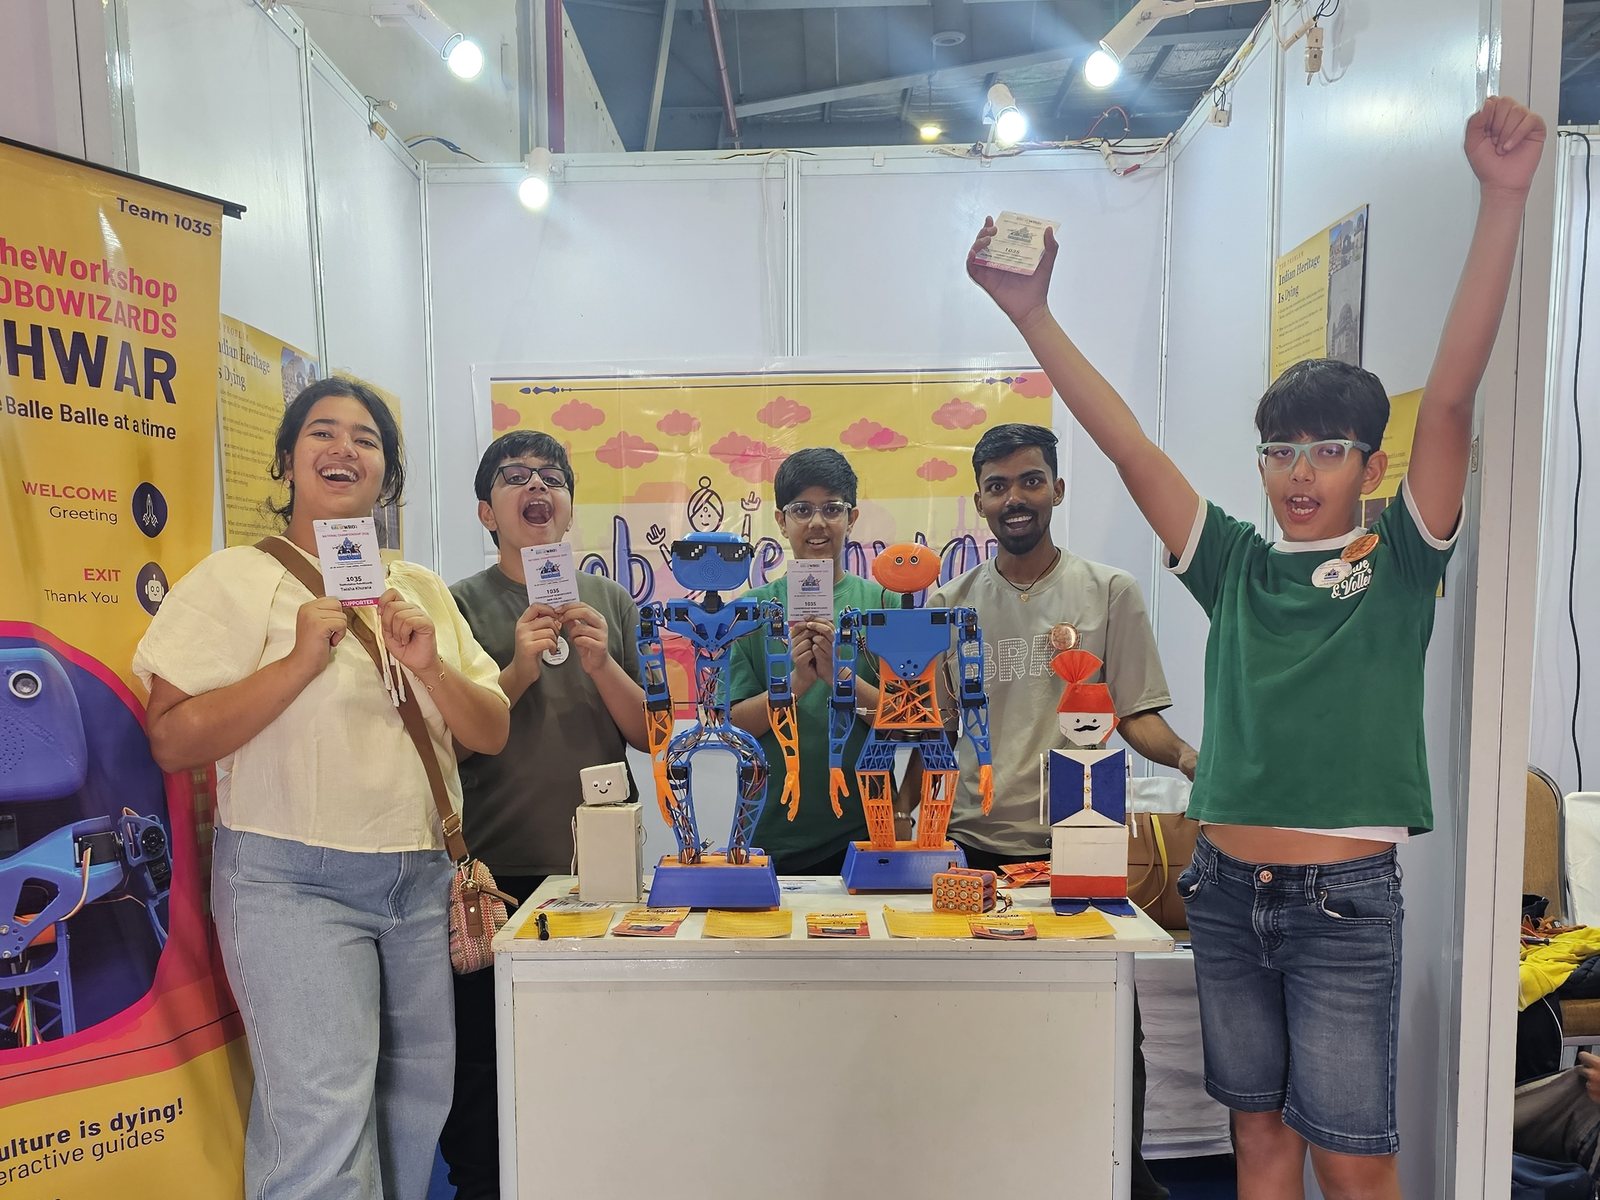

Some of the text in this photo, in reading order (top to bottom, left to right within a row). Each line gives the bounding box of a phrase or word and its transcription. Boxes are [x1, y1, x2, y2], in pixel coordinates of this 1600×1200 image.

[116, 197, 213, 237] Team 1035
[1279, 254, 1321, 286] Indian Heritage
[1285, 285, 1299, 303] Dying
[0, 319, 177, 404] HWAR
[240, 346, 271, 376] Heritage
[224, 365, 247, 392] Dying
[5, 395, 54, 421] Balle
[59, 403, 109, 428] Balle
[114, 413, 129, 431] at
[132, 419, 140, 433] a
[141, 416, 177, 440] time
[21, 480, 118, 503] WELCOME
[49, 505, 118, 525] Greeting
[83, 567, 121, 582] EXIT
[44, 589, 119, 604] Thank You
[341, 599, 374, 607] SUPPORTER
[79, 1120, 102, 1139] is
[110, 1097, 184, 1133] dying!
[91, 1127, 166, 1161] guides
